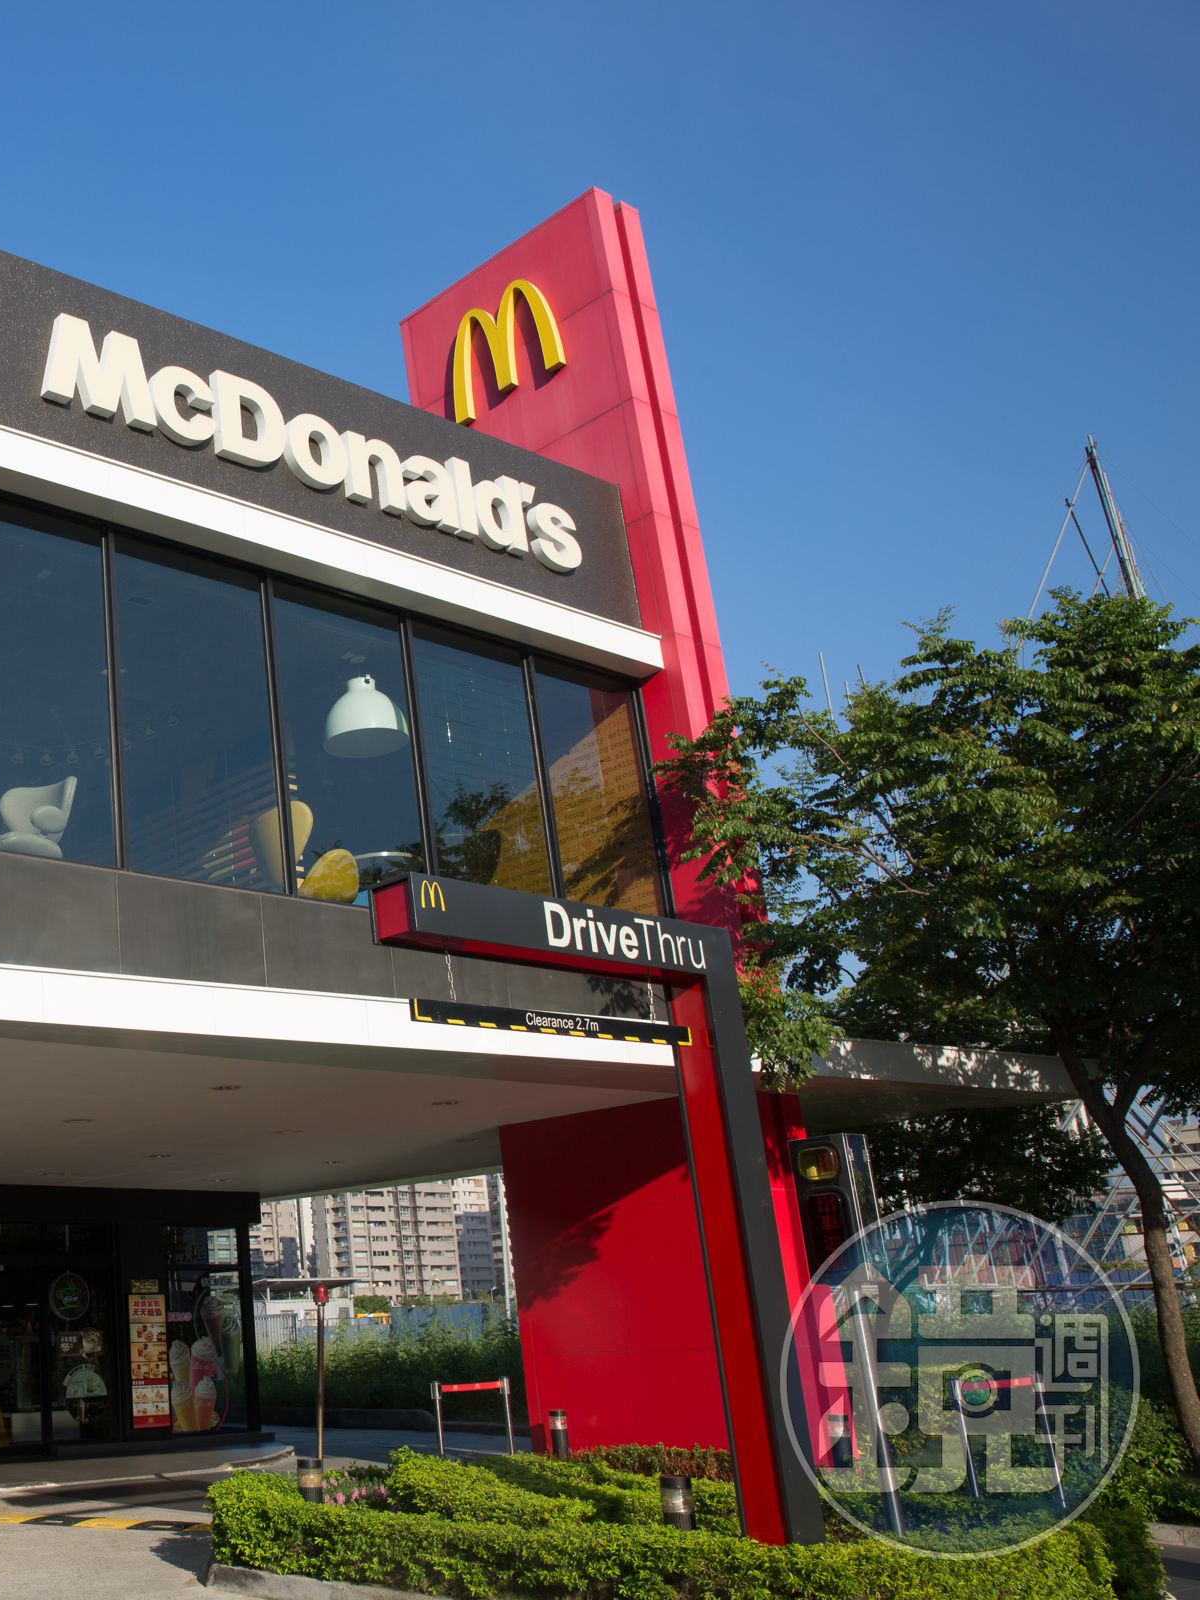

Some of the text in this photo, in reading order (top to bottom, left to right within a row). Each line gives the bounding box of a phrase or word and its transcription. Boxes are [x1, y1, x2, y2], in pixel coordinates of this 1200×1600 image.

[40, 312, 583, 573] McDonald's
[525, 1012, 600, 1032] Clearance 2.7m
